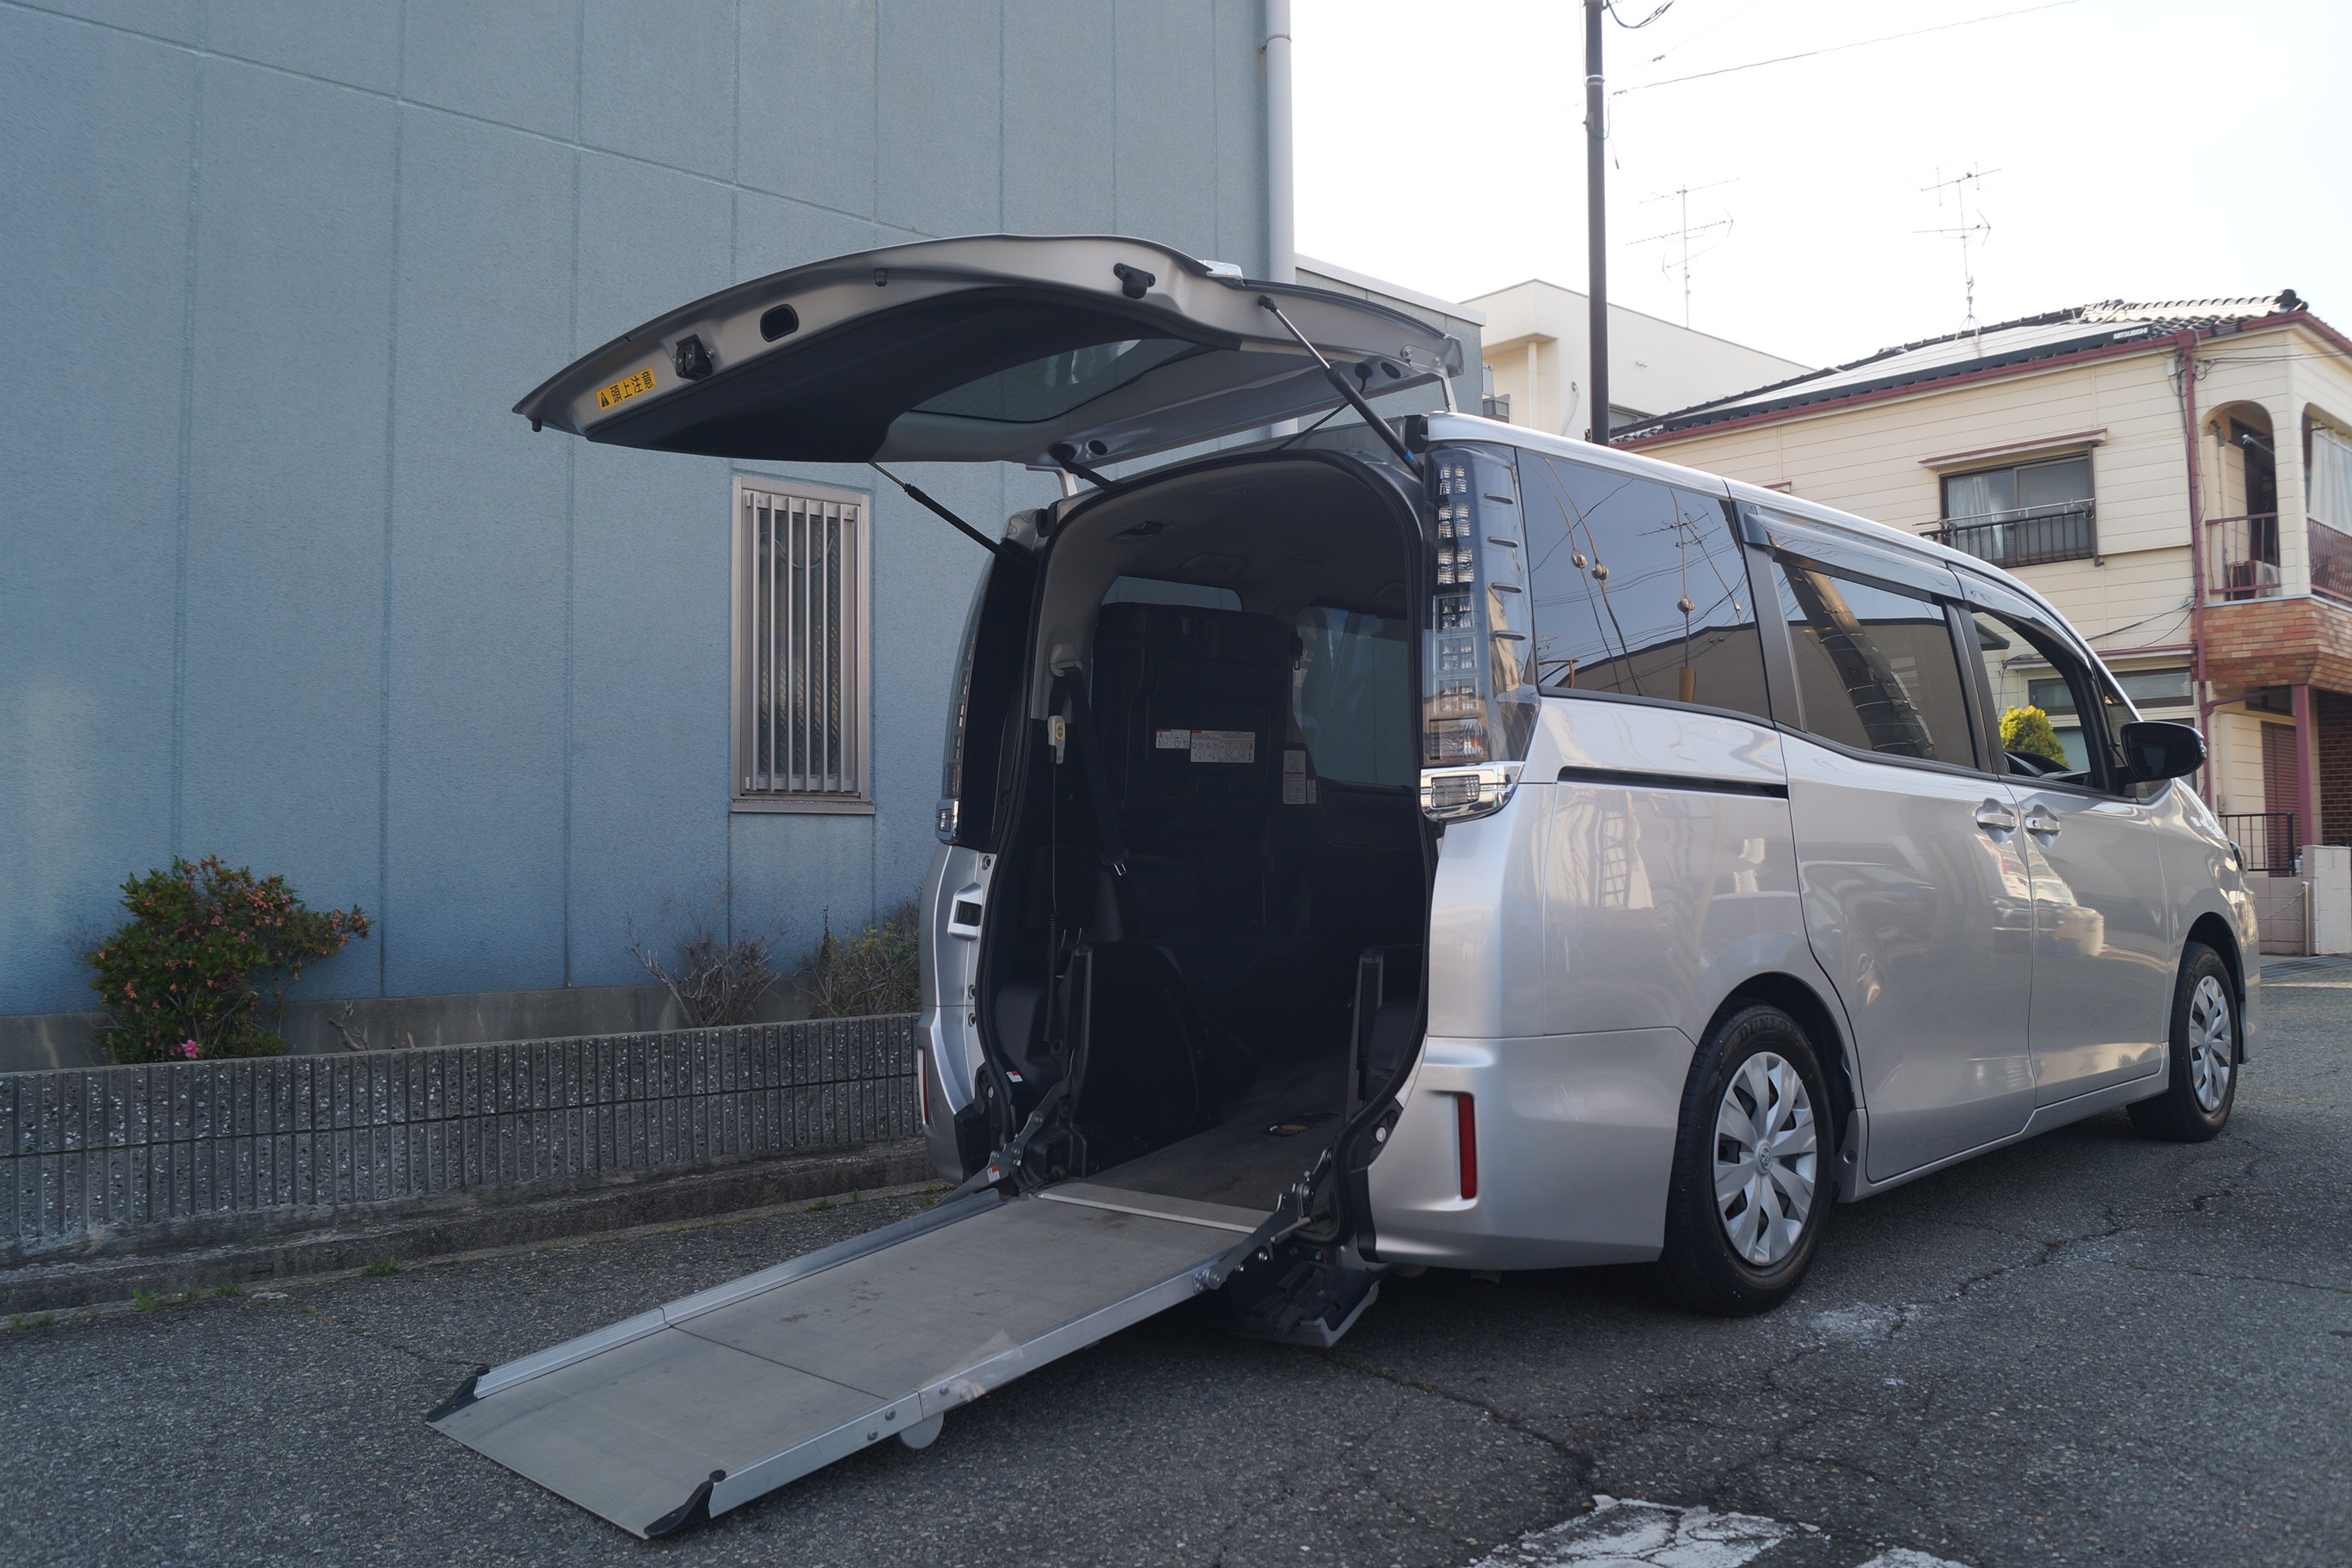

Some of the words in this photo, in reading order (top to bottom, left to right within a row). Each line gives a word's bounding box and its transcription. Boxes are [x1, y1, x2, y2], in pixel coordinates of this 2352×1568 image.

[2113, 327, 2149, 340] MITSUBISHI
[609, 371, 654, 403] 頭上注意
[1737, 1016, 1799, 1043] DUNLOP
